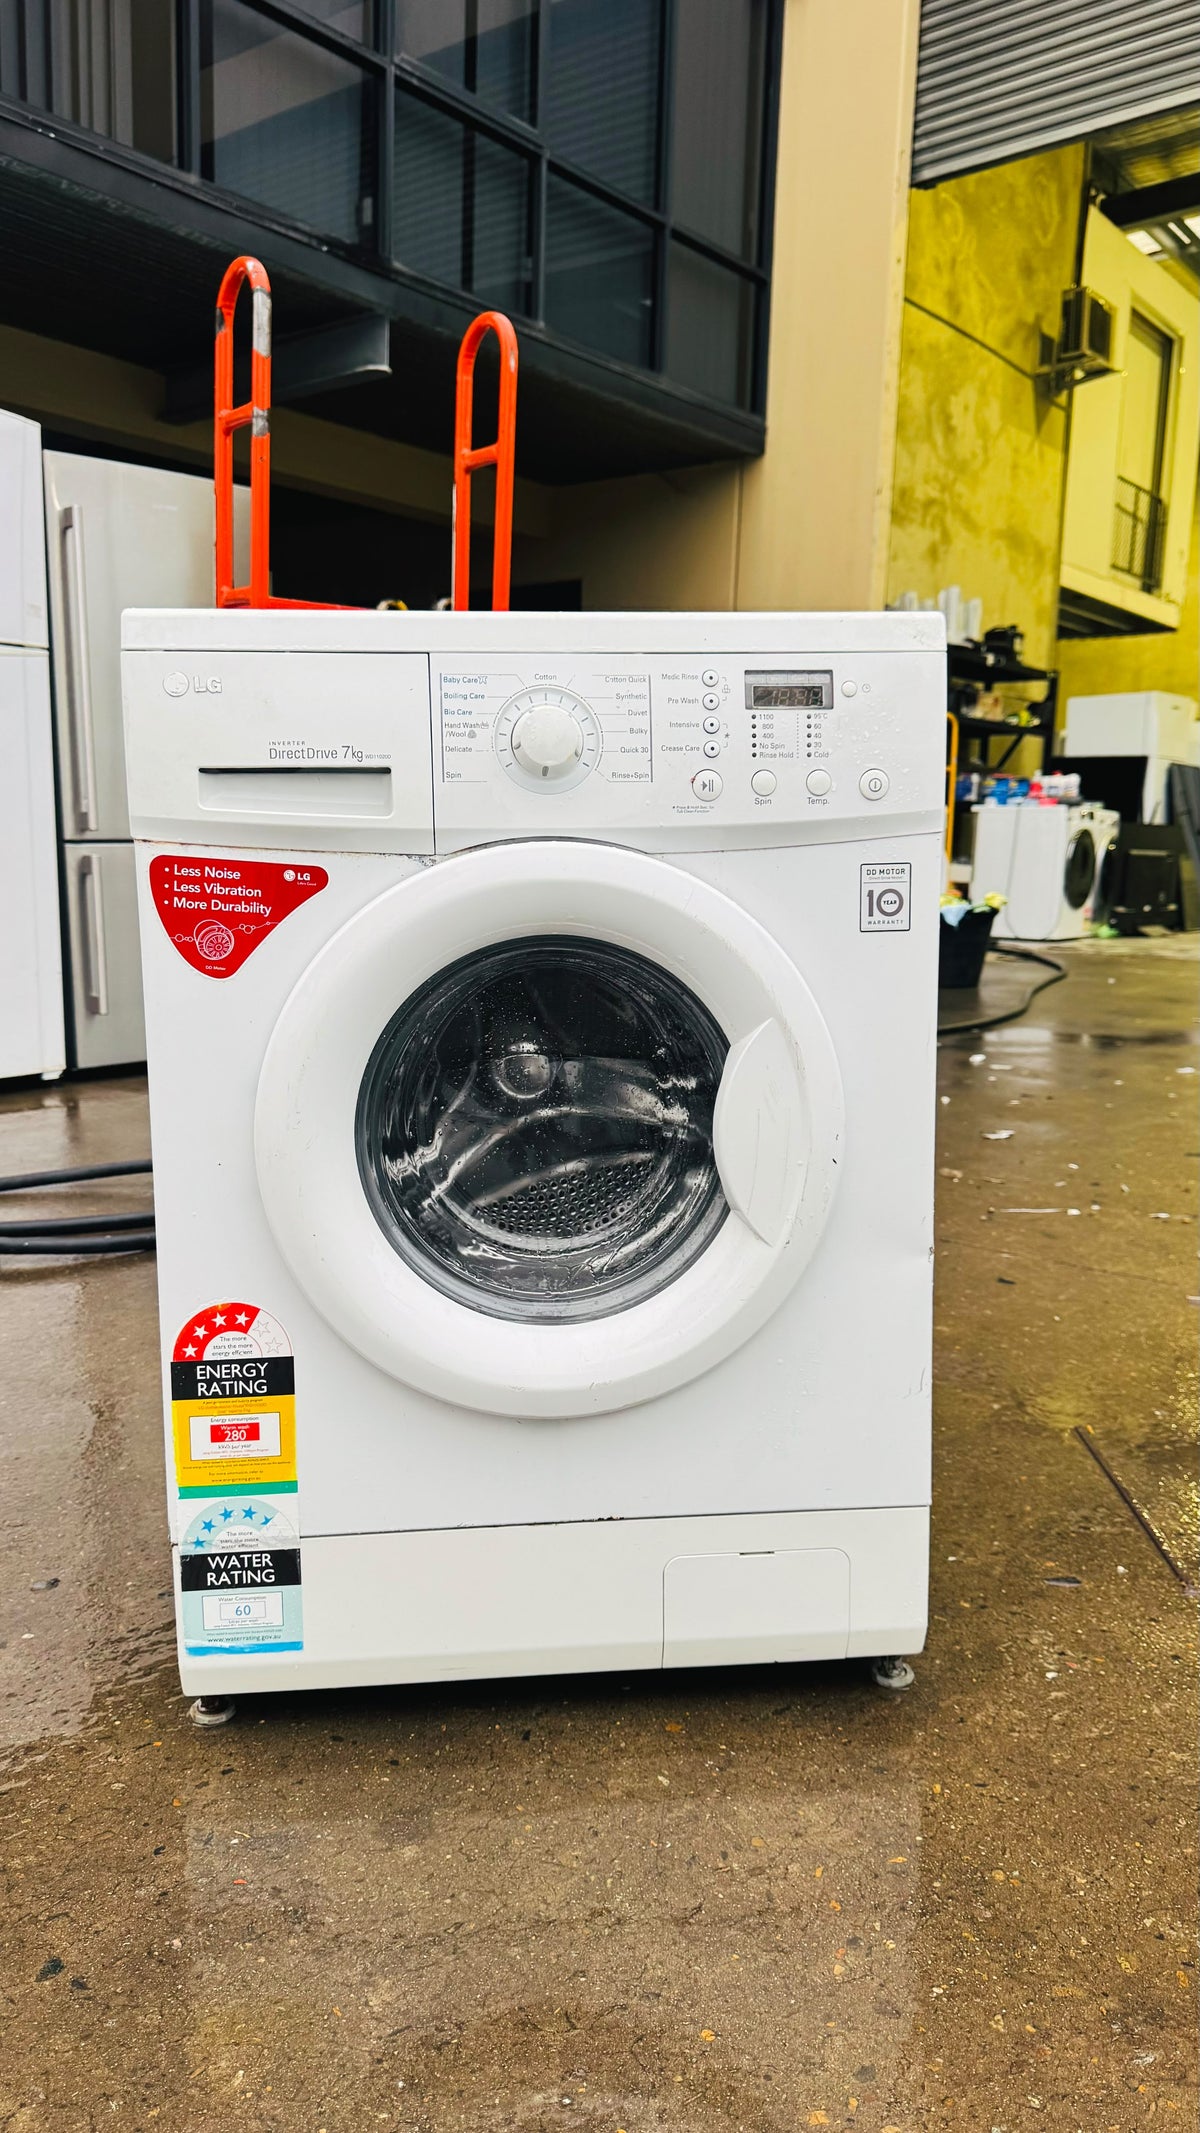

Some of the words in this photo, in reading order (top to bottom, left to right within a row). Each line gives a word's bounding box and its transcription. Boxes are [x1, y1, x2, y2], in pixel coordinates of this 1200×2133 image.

[443, 676, 464, 684] Baby
[465, 676, 478, 684] Care
[534, 673, 557, 681] Cotton
[628, 675, 647, 684] Quick
[661, 672, 679, 680] Medic
[680, 673, 699, 681] Rinse
[193, 676, 222, 693] LG
[444, 692, 469, 701] Boiling
[470, 692, 485, 700] Care
[615, 692, 647, 701] Synthetic
[680, 696, 699, 704] Wash
[444, 708, 456, 716] Bio
[457, 708, 472, 716] Care
[628, 709, 648, 717] Duvet
[444, 722, 461, 730] Hand
[669, 720, 700, 729] Intensive
[445, 730, 466, 738] /Wool
[629, 727, 648, 736] Bulky
[762, 732, 774, 740] 400
[814, 732, 822, 740] 40
[445, 745, 472, 753] Delicate
[620, 746, 639, 754] Quick
[640, 746, 649, 754] 30
[660, 744, 683, 753] Crease
[684, 744, 700, 753] Care
[759, 742, 769, 750] No
[770, 742, 786, 750] Spin
[446, 771, 462, 780] Spin
[754, 797, 772, 806] Spin
[806, 797, 830, 806] Temp.
[174, 864, 201, 877] Less
[204, 866, 241, 880] Noise
[297, 872, 311, 881] LG
[173, 880, 200, 893] Less
[204, 882, 262, 898] Vibration
[173, 897, 207, 910] More
[211, 899, 272, 917] Durability
[867, 889, 904, 917] 10
[196, 1362, 268, 1380] ENERGY
[197, 1380, 268, 1397] RATING
[224, 1430, 247, 1442] 280
[207, 1553, 273, 1570] WATER
[206, 1569, 276, 1586] RATING
[235, 1604, 251, 1616] 60
